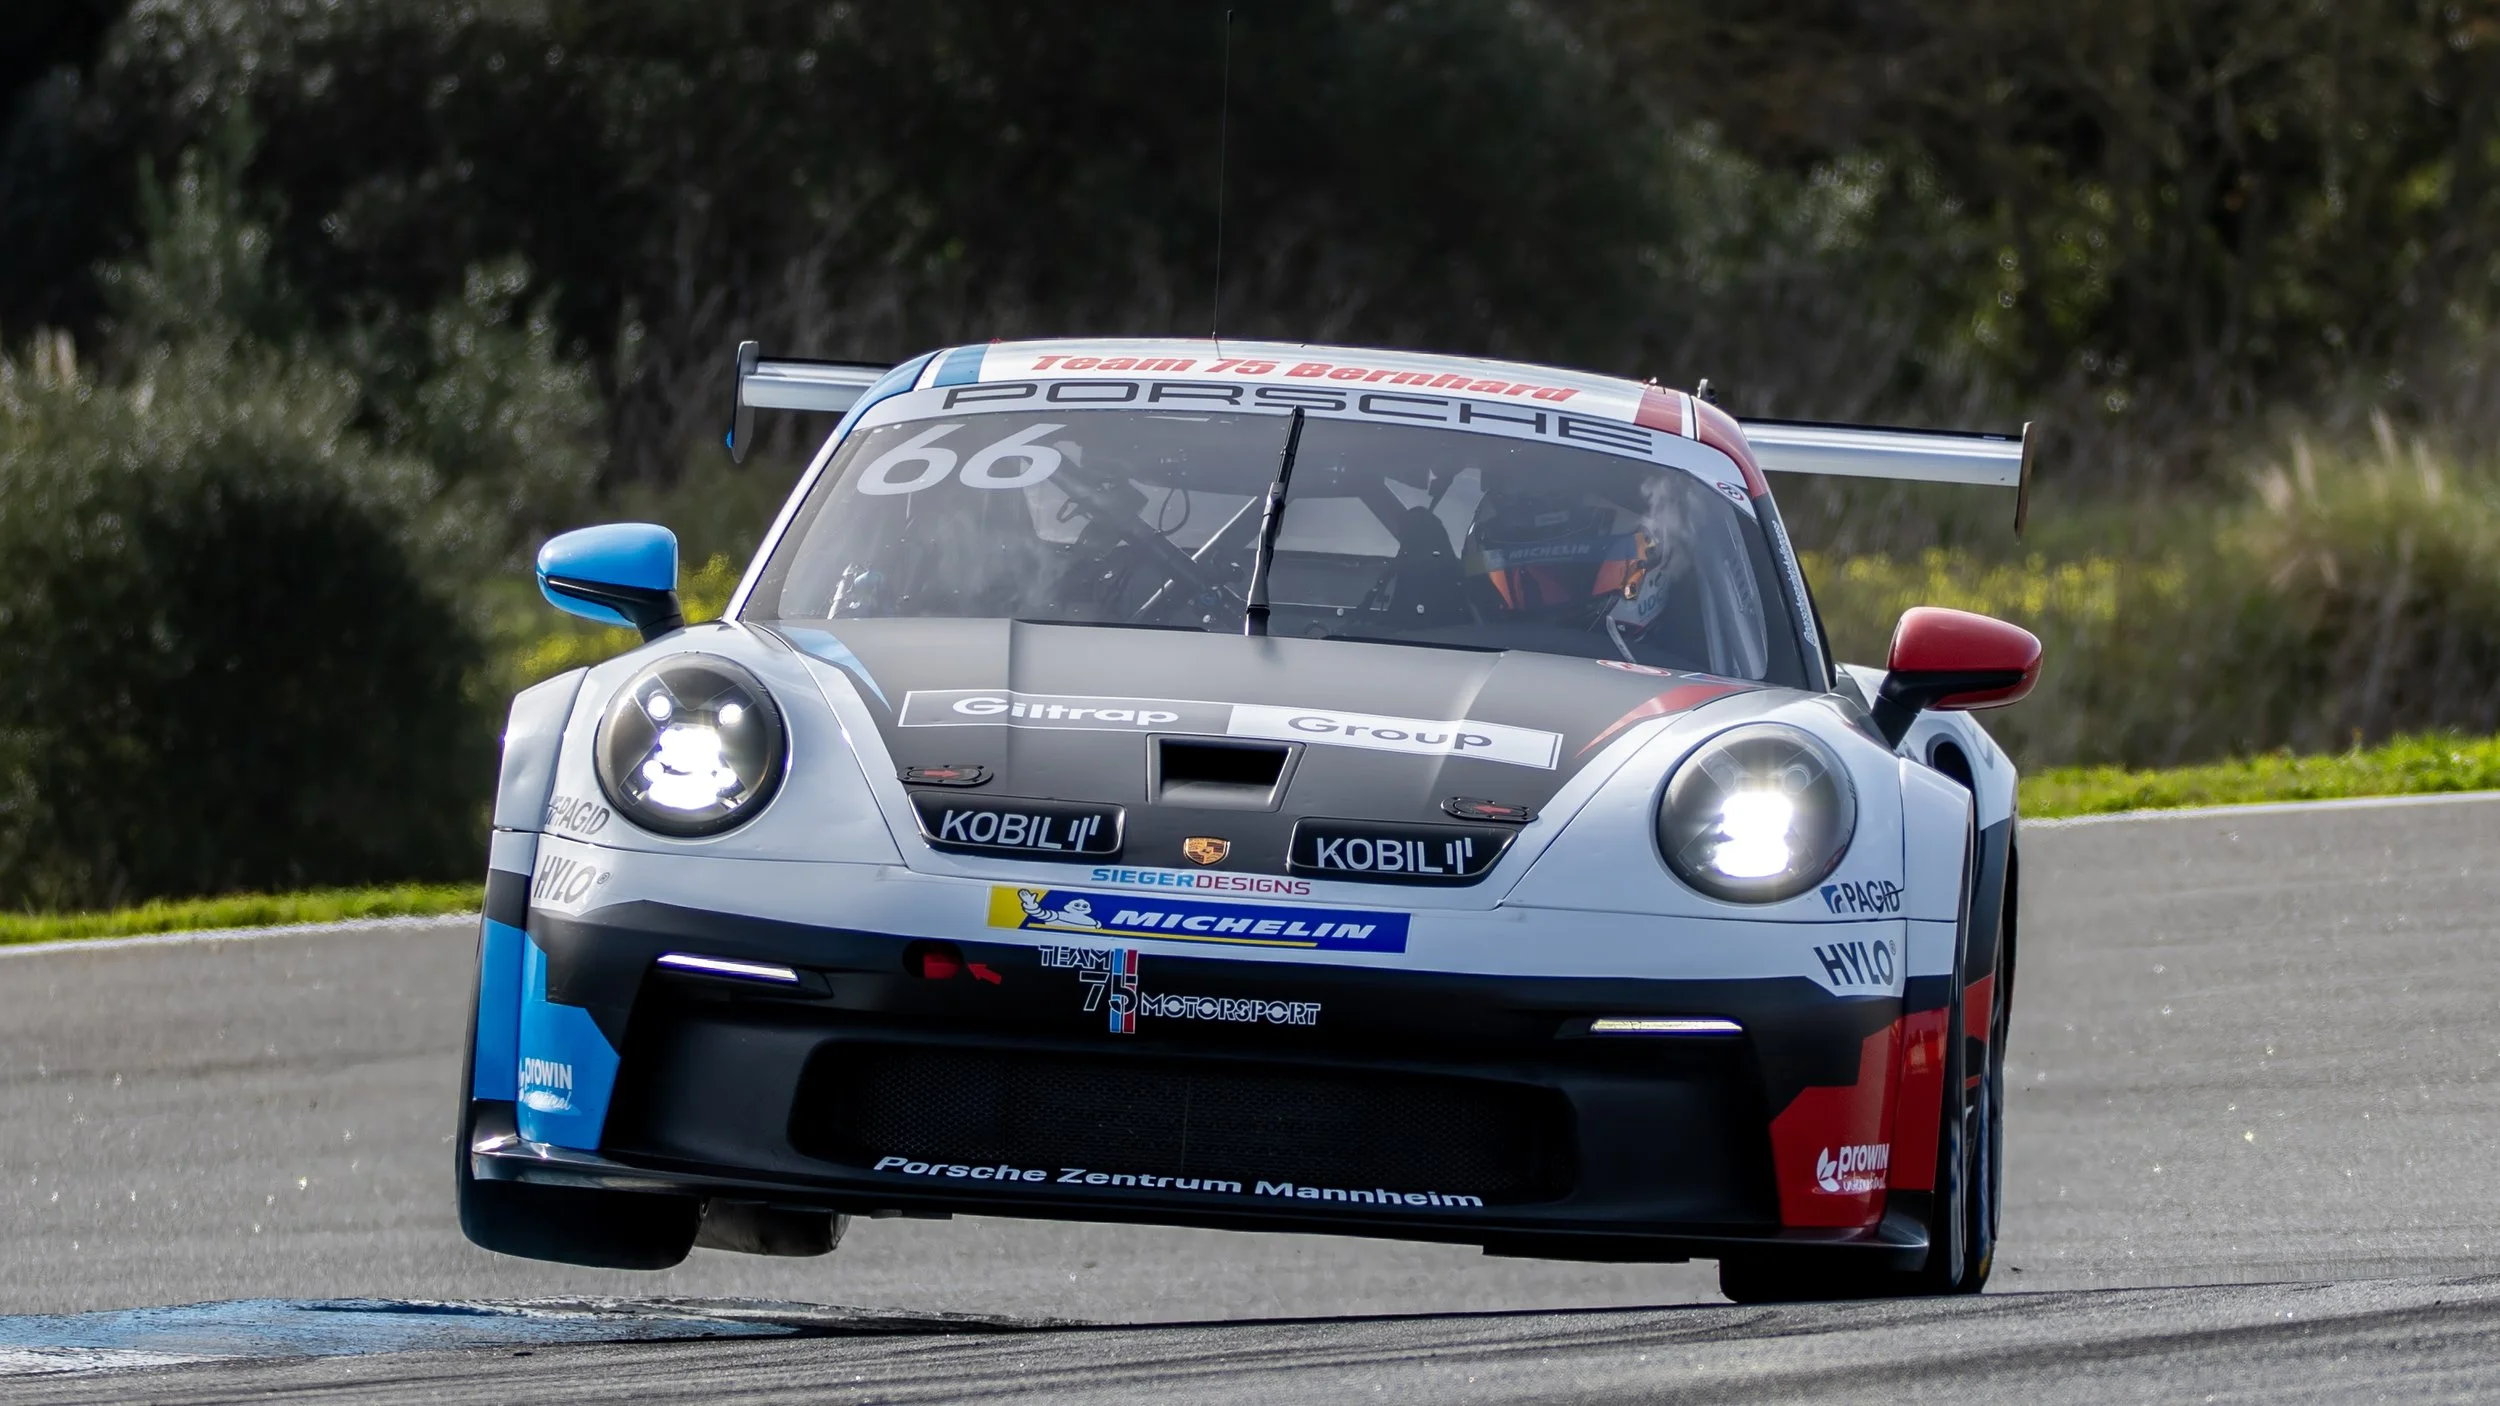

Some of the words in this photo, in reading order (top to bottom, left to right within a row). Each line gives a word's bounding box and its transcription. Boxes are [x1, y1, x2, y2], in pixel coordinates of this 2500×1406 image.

[1030, 355, 1201, 373] Team
[1204, 357, 1278, 376] 75
[1285, 362, 1581, 402] Bernhard
[943, 381, 1653, 455] PORSCHE
[857, 422, 1068, 496] 66
[1509, 543, 1592, 560] MICHELIN
[952, 696, 1180, 727] Giltrap
[1287, 715, 1493, 751] Group
[555, 797, 611, 835] PAGID
[940, 809, 1064, 851] KOBIL
[1317, 837, 1443, 875] KOBIL
[1091, 868, 1312, 897] SIEGERDESIGNS
[1840, 880, 1901, 914] PAGID
[1110, 909, 1378, 940] MICHELIN
[1038, 944, 1111, 971] TEAM
[1078, 970, 1139, 1016] 75
[1140, 994, 1322, 1026] MOTORSPORT
[873, 1155, 1048, 1183] Porsche
[1056, 1167, 1242, 1194] Zentrum
[1254, 1180, 1485, 1208] Mannheim
